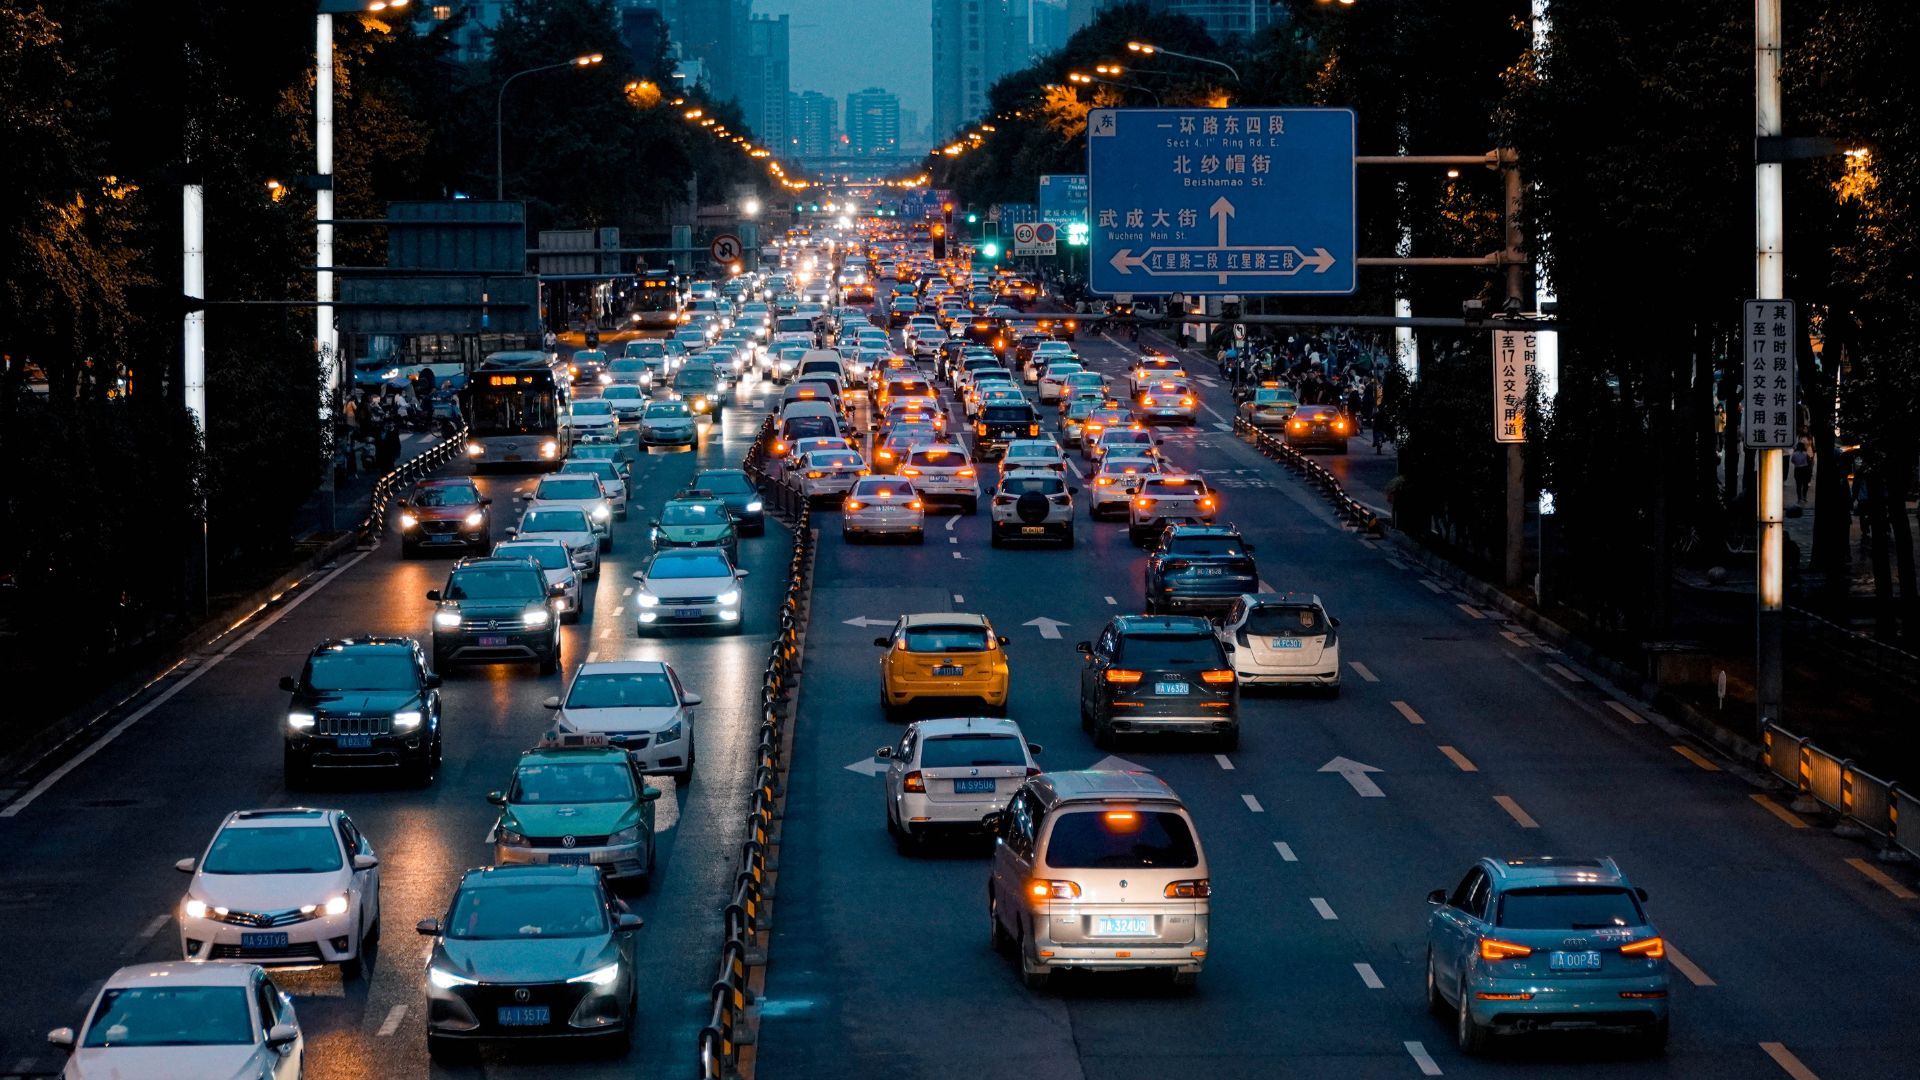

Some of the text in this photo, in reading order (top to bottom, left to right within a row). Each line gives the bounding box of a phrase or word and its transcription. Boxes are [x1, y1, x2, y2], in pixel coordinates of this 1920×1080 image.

[1101, 114, 1113, 128] 东
[1157, 115, 1285, 135] 一环路东四段
[1167, 138, 1190, 148] Sect
[1222, 138, 1243, 149] Ring
[1249, 138, 1264, 148] Rd.
[1173, 154, 1271, 174] 北纱帽街
[1184, 177, 1266, 187] Beishamao St.
[1099, 208, 1197, 228] 武成大街
[1019, 229, 1031, 238] 60
[1108, 231, 1143, 242] Wucheng
[1150, 231, 1168, 240] Main
[1152, 253, 1218, 270] 红星路二段
[1227, 253, 1294, 270] 红星路三段
[1753, 305, 1767, 443] 7至17公交专用道
[1773, 305, 1787, 443] 其他时段允许通行
[1502, 330, 1516, 436] 至17公交专用道
[585, 736, 604, 746] TAXI
